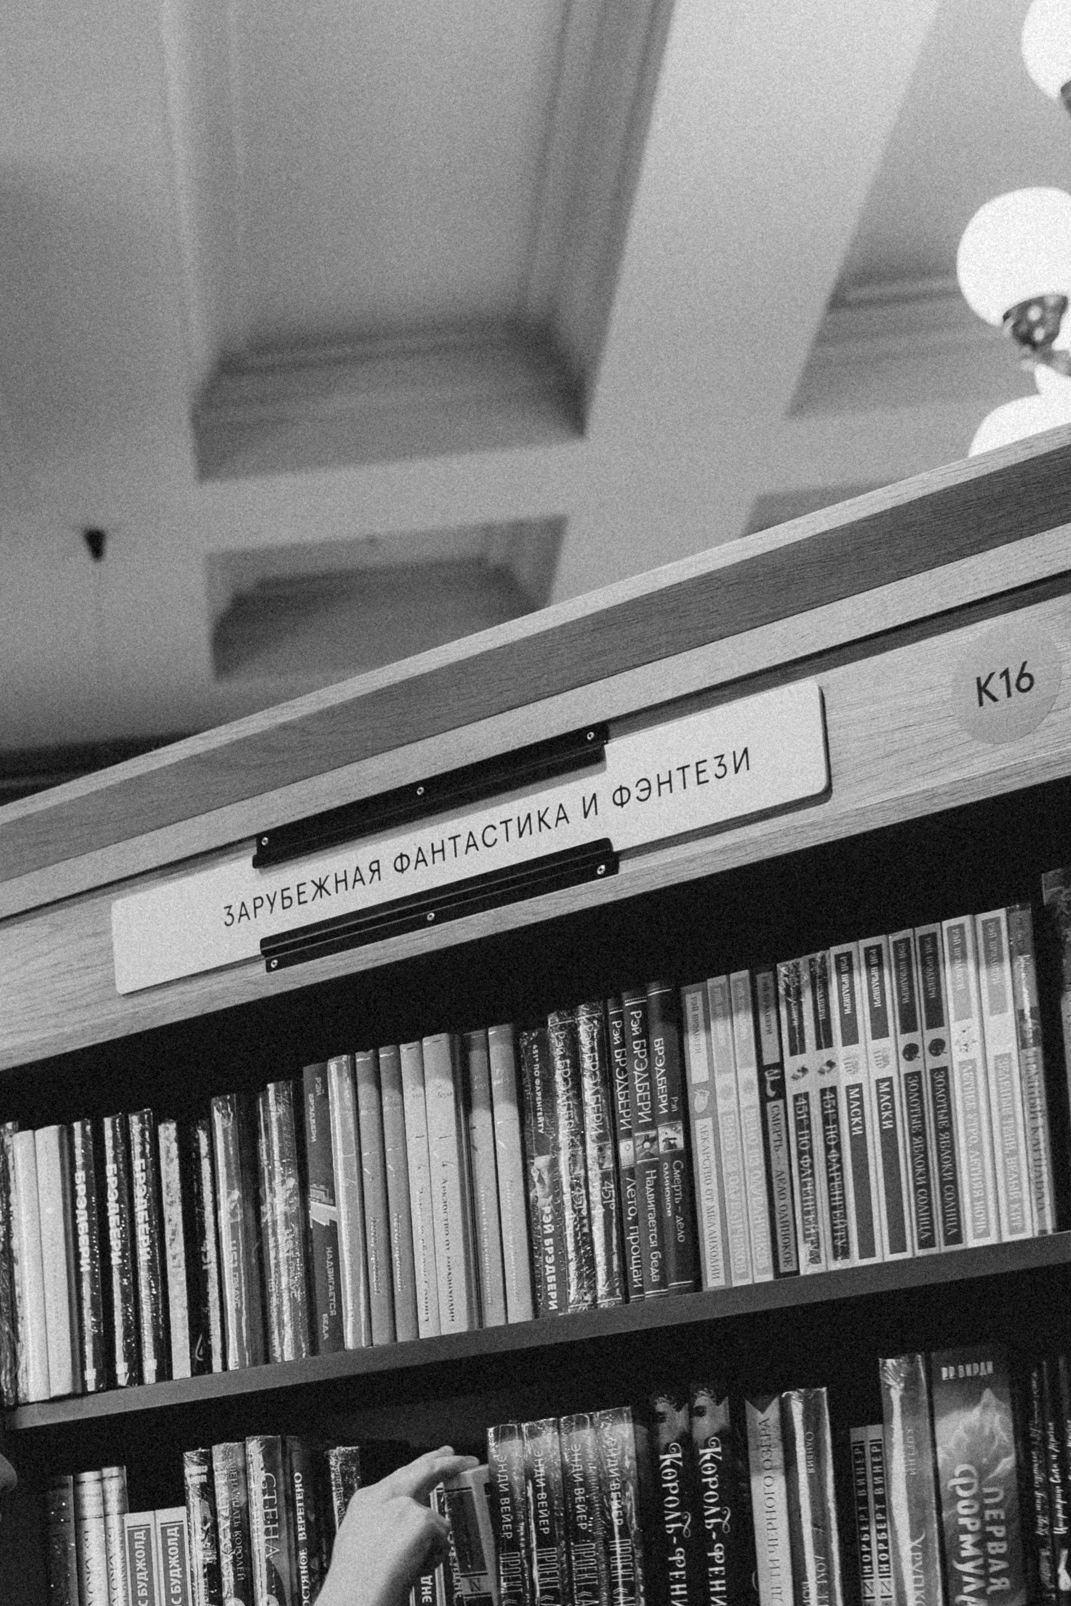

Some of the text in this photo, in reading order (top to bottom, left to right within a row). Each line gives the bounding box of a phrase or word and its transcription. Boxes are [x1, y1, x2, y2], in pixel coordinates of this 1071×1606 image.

[222, 746, 753, 928] ЗАРУБЕЖНАЯ ФАНТАСТИКА И ФЭНТЕЗИ
[611, 1020, 632, 1131] Рэй БРЭДБЕРИ
[629, 1010, 652, 1124] Рэй БРЭДБЕРИ
[653, 1037, 669, 1114] БРЭДБЕРИ
[878, 1081, 894, 1130] МАСКИ
[798, 1131, 812, 1151] ПО
[825, 1125, 839, 1147] ПО
[847, 1088, 863, 1136] МАСКИ
[933, 1070, 959, 1237] ЗОЛОТЫЕ ЯБЛОКИ СОЛНЦА
[698, 1123, 713, 1187] ЛЕКАРСТВО
[769, 1104, 793, 1269] СМЕРТЬ ДЕЛО ОДИНОКОЕ
[906, 1075, 932, 1241] ЗОЛОТЫЕ ЯБЛОКИ СОЛНЦА
[74, 1171, 90, 1272] БРЭДБЕРИ
[105, 1164, 122, 1266] БРЭДБЕРИ
[134, 1158, 151, 1262] БРЭДБЕРИ
[645, 1169, 663, 1283] Надвигается беда
[672, 1160, 688, 1243] Смерть дело
[543, 1238, 559, 1310] БРЭДБЕРИ
[294, 1472, 308, 1540] ВЕРЕТЕНО
[496, 1454, 510, 1493] ЭНДИ
[533, 1449, 550, 1535] ЭНДИ ВЕЙЕР
[571, 1443, 588, 1531] ЭНДИ ВЕЙЕР
[758, 1417, 784, 1603] ДЕТИ ЧЕРНОГО ОЗЕРА
[871, 1445, 888, 1572] НОРБЕРТ ВИНЕР
[132, 1530, 148, 1596] БУДЖОЛД
[165, 1526, 182, 1593] БУДЖОЛД
[499, 1550, 524, 1595] ПРОЕКТ
[536, 1546, 561, 1591] ПРОЕКТ
[572, 1541, 599, 1587] ПРОЕКТ
[609, 1538, 635, 1583] ПРОЕКТ
[981, 1486, 1012, 1596] ПЕРВАЯ
